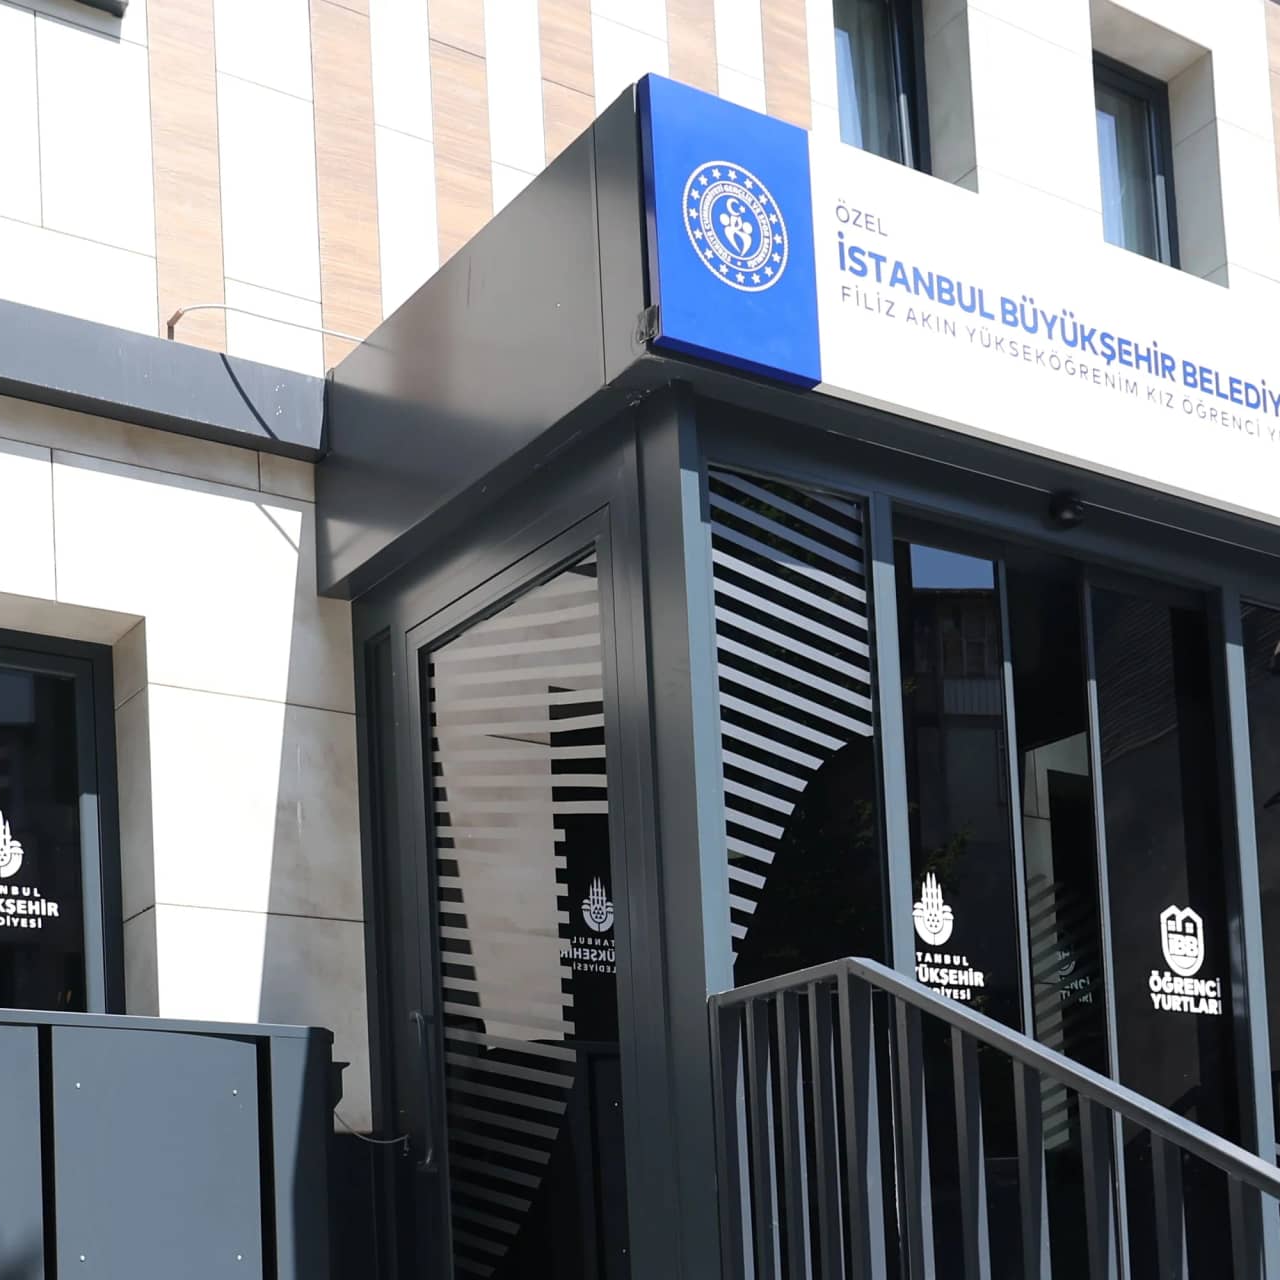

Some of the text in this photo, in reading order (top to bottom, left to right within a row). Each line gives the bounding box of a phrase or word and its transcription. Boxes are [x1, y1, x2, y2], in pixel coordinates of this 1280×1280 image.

[835, 198, 888, 237] ÖZEL
[837, 230, 995, 321] İSTANBUL
[1000, 294, 1176, 383] BÜYÜKŞEHİR
[841, 285, 895, 318] FİLİZ
[906, 307, 956, 337] AKIN
[966, 325, 1138, 395] YÜKSEKÖĞRENİM
[1147, 385, 1174, 409] KIZ
[1182, 395, 1260, 438] ÖĞRENCİ
[916, 952, 969, 966] TANBUL
[1149, 970, 1222, 998] ÖĞRENCİ
[1150, 993, 1223, 1015] YURTLARI
